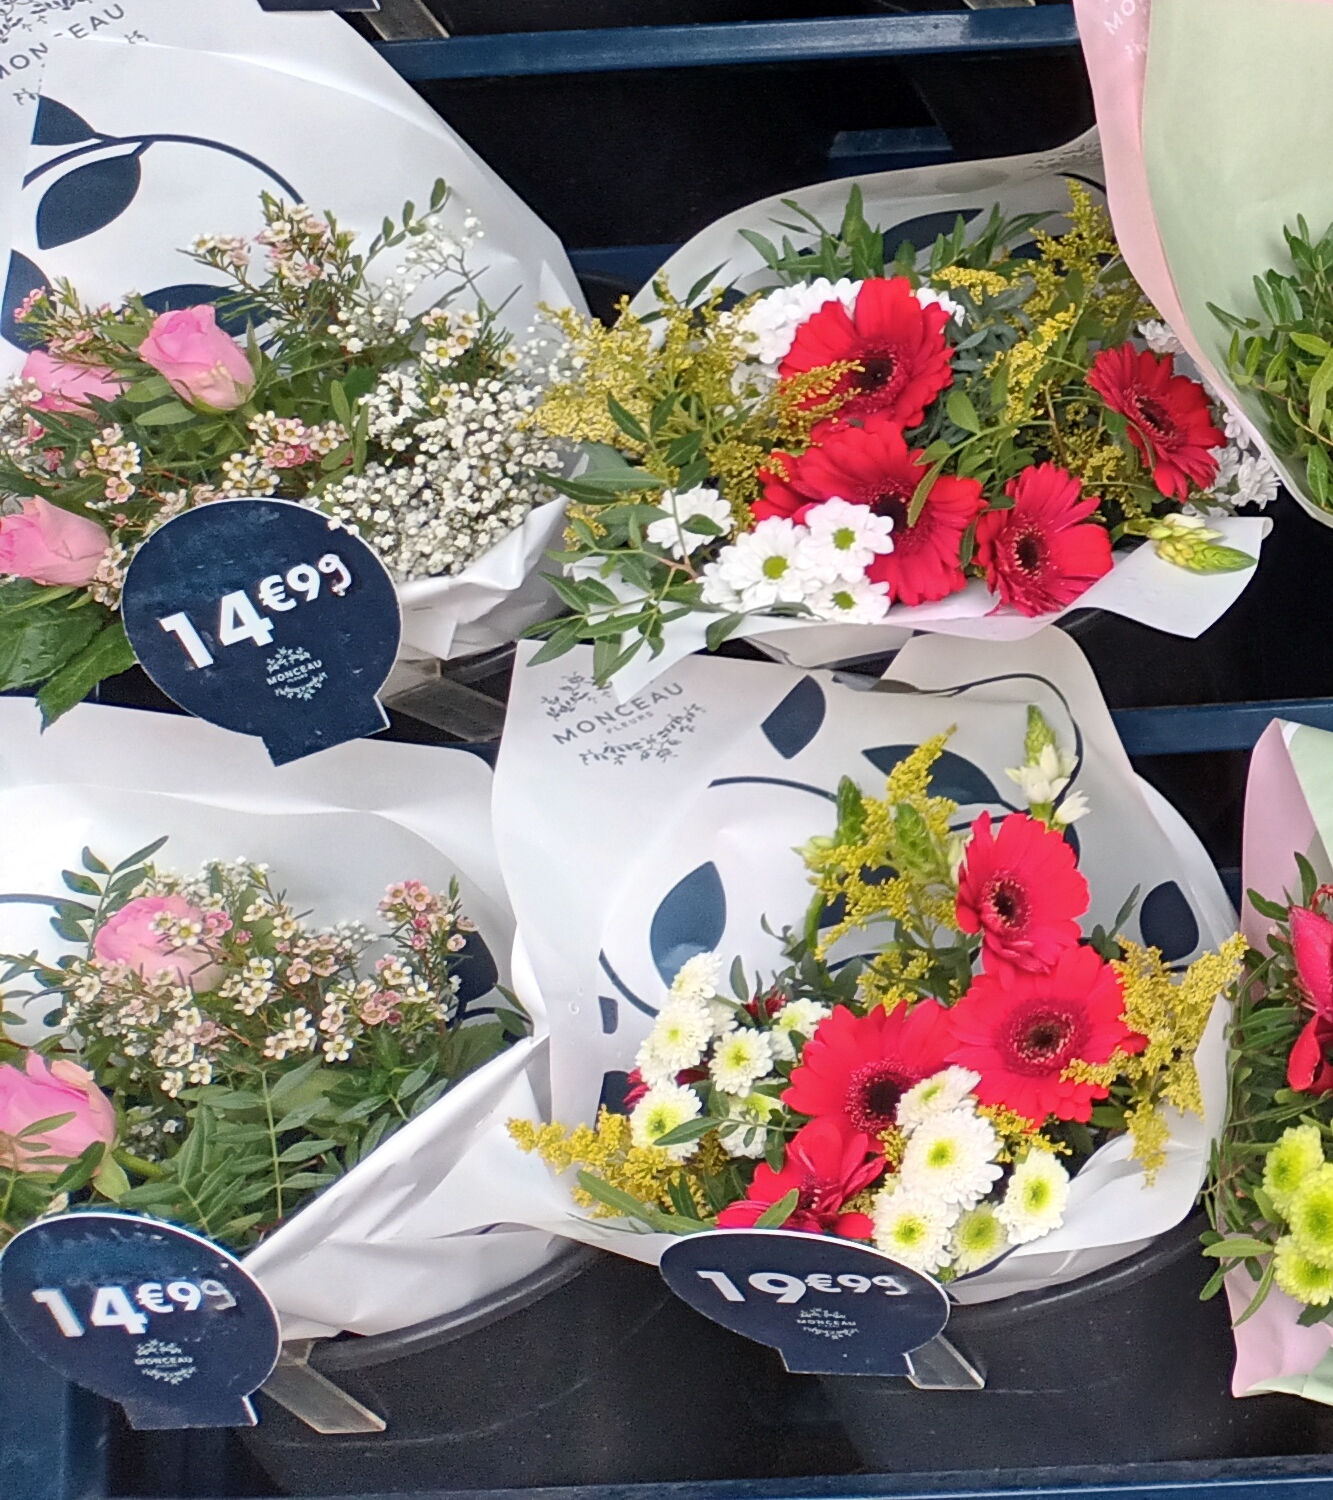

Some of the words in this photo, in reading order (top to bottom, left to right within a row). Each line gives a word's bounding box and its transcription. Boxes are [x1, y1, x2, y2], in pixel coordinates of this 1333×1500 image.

[158, 552, 353, 670] 14€99
[266, 659, 323, 686] MONCEAU
[552, 682, 684, 745] MONCEAU
[31, 1278, 238, 1338] 14€99
[696, 1270, 910, 1304] 19€99
